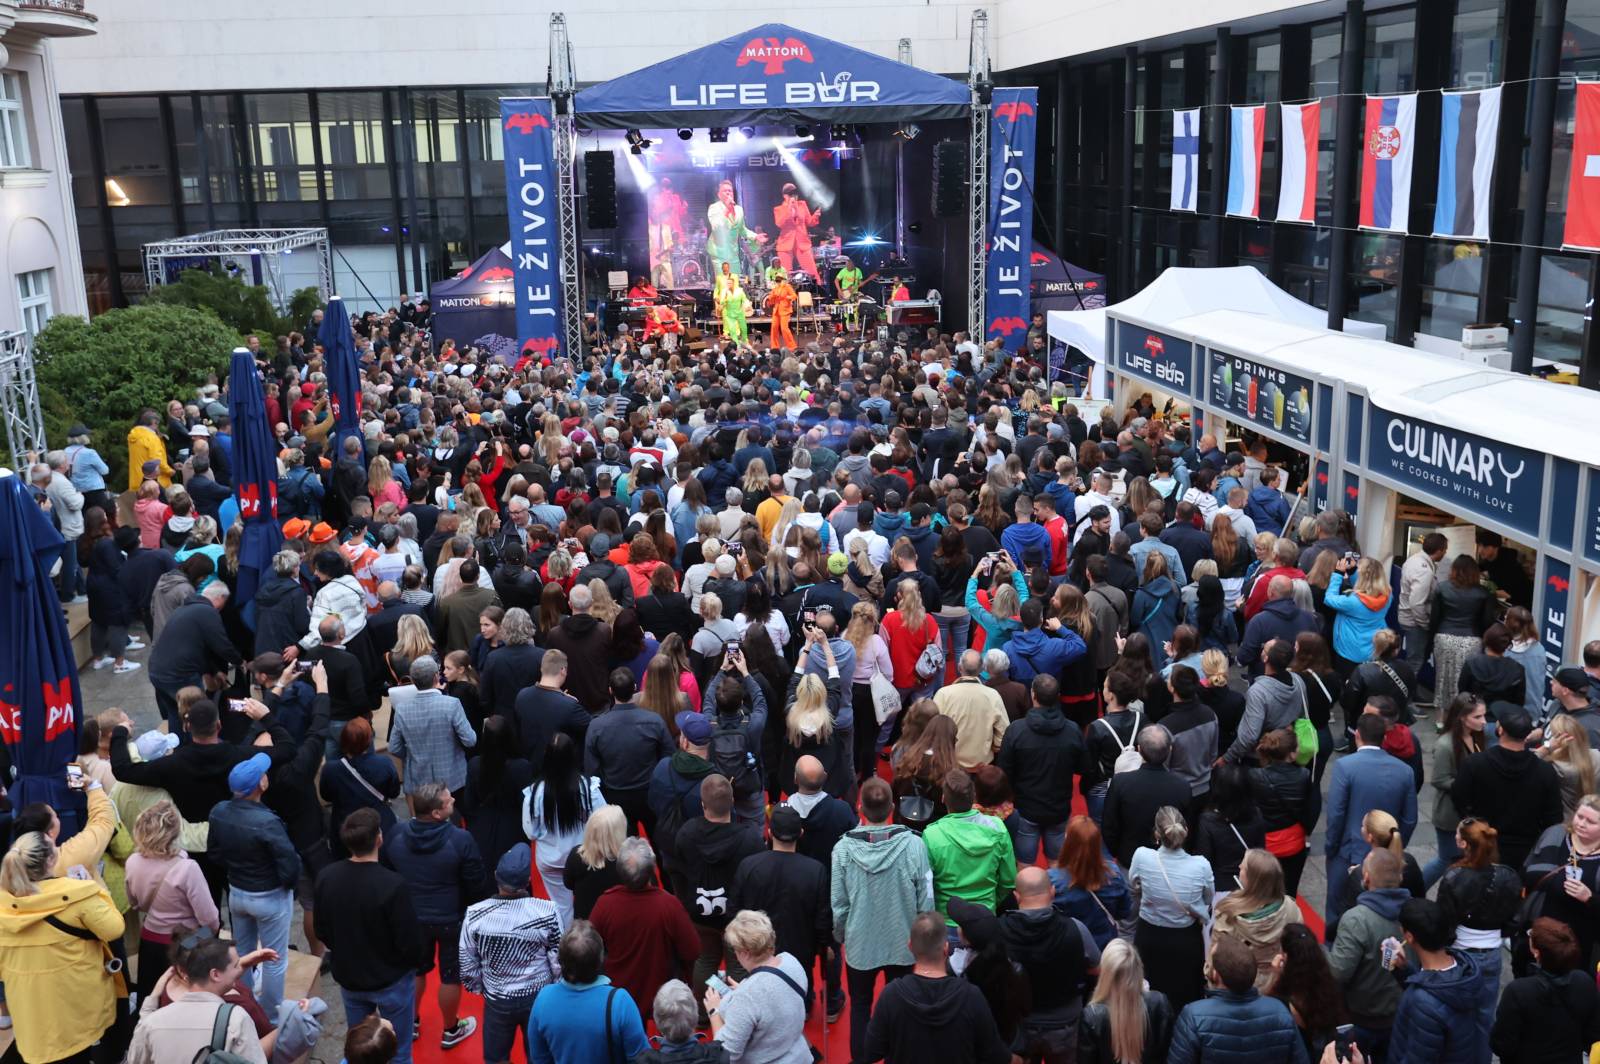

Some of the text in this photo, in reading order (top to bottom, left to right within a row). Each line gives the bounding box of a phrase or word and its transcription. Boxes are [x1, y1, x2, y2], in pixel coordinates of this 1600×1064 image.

[746, 46, 805, 57] MATTONI
[669, 83, 768, 106] LIFE
[993, 144, 1024, 297] JE ŽIVOT
[518, 157, 557, 317] JE ŽIVOT
[1045, 282, 1084, 292] MATTONI
[440, 297, 481, 307] MATTONI
[1125, 352, 1152, 374] LIFE
[1234, 359, 1286, 384] DRINKS
[1387, 418, 1525, 494] CULINARY
[1391, 459, 1513, 513] WE COOKED WITH LOVE
